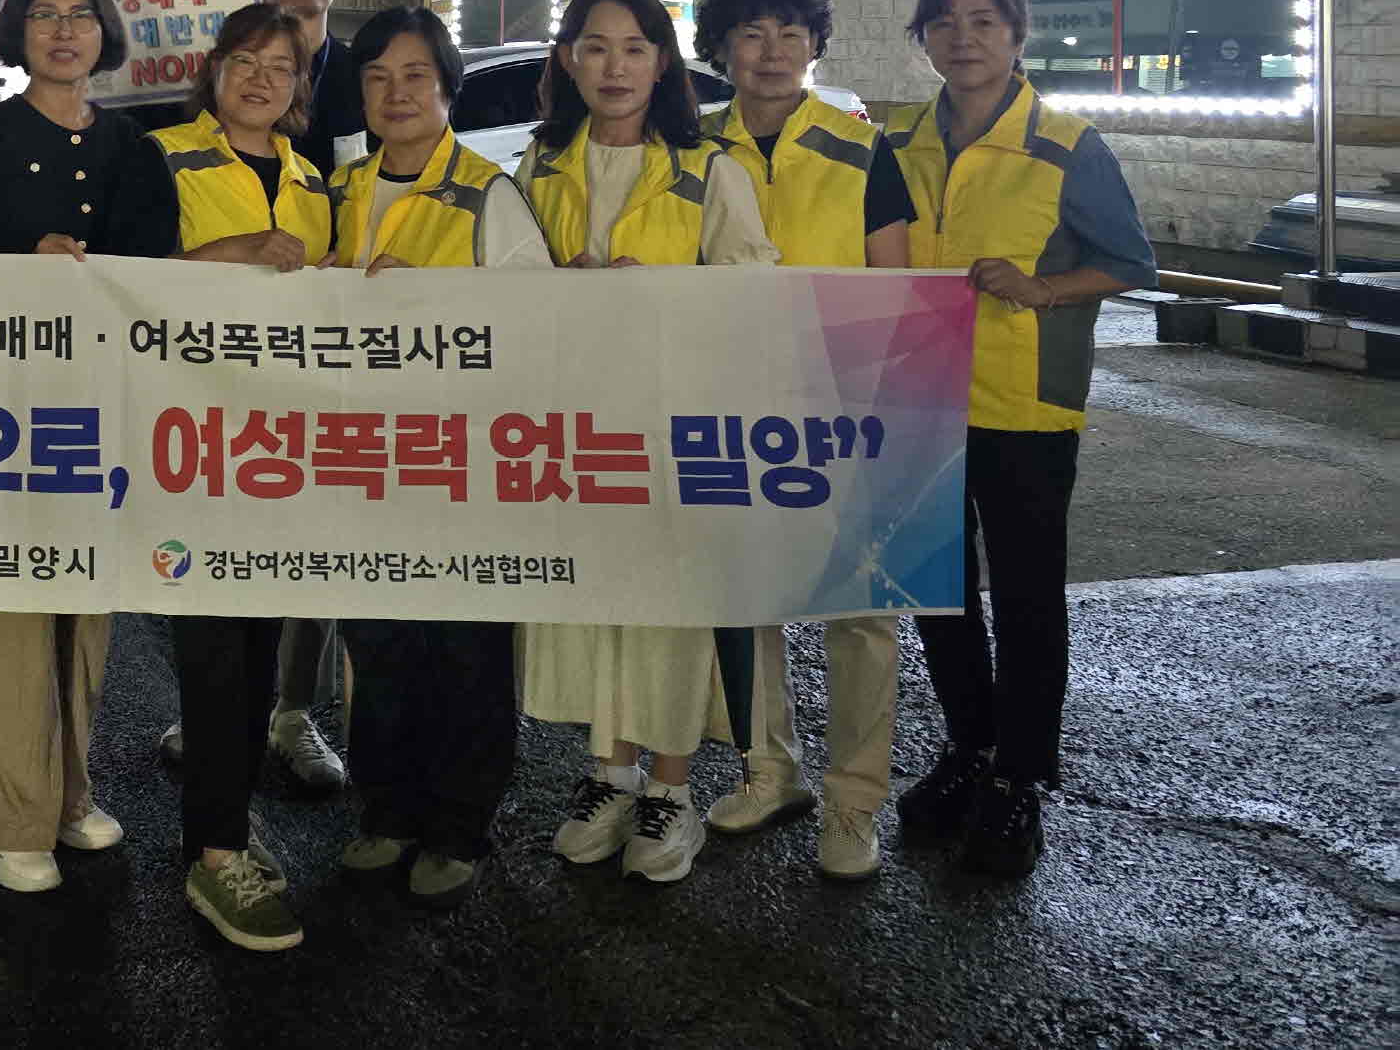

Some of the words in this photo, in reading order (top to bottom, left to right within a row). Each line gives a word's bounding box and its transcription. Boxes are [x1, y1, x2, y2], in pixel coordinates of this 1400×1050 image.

[131, 11, 225, 48] 대반대
[129, 318, 493, 370] 여성폭력근절사업
[152, 406, 468, 503] 여성폭력
[488, 411, 651, 505] 없는
[204, 548, 576, 585] 경남여성복지상담소·시설협의회
